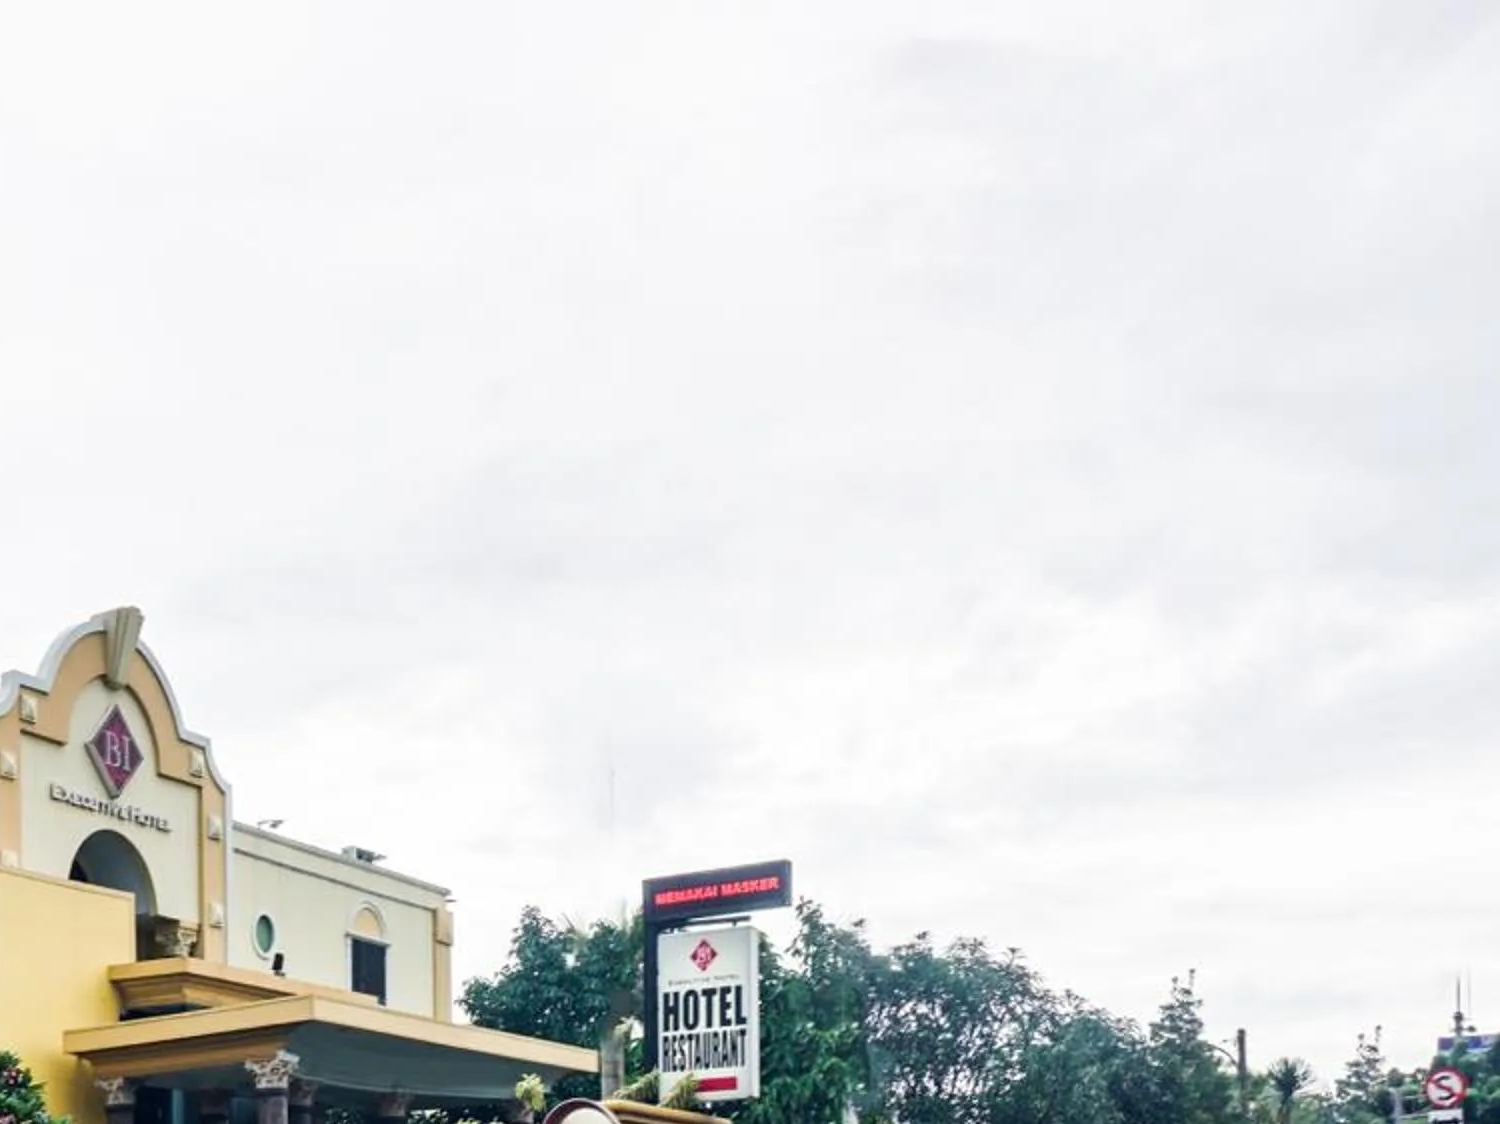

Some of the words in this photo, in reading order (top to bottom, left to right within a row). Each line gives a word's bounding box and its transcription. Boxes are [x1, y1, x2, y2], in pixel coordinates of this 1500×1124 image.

[721, 876, 780, 897] MASKER
[662, 985, 747, 1033] HOTEL
[662, 1029, 747, 1073] RESTAURANT
